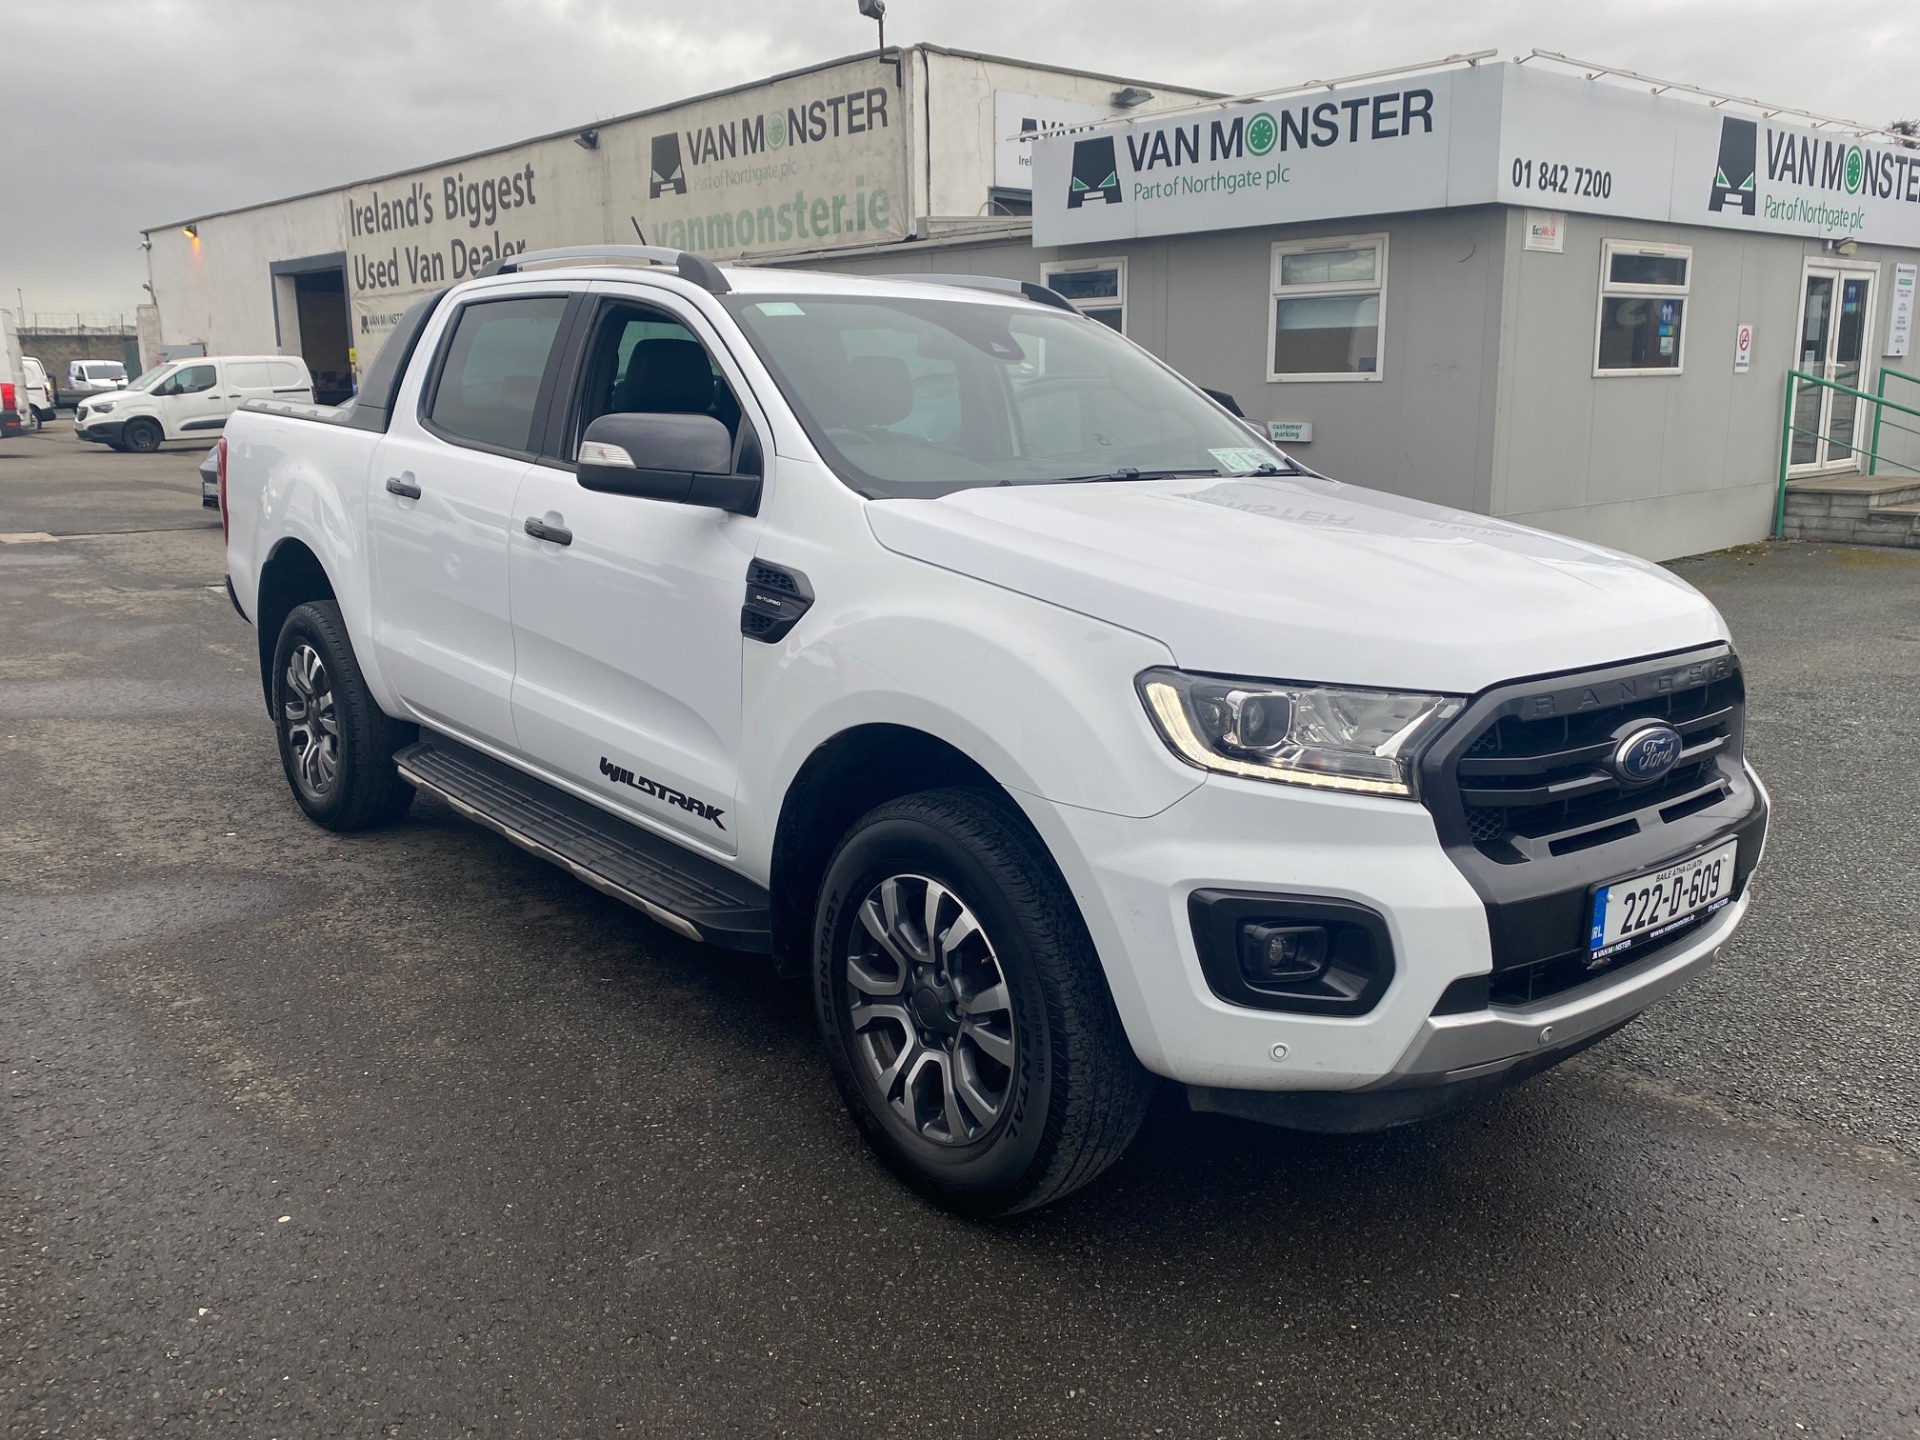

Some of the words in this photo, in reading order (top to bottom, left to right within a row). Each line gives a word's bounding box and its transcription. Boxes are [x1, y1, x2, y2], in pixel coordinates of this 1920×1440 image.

[686, 121, 737, 166] VAN
[742, 86, 888, 156] MONSTER
[1126, 123, 1200, 172] VAN
[1209, 88, 1434, 162] MONSTER
[712, 167, 726, 189] of
[725, 160, 779, 188] Northgate
[780, 156, 797, 184] plc
[1134, 181, 1162, 201] Part
[1163, 175, 1180, 198] of
[1182, 170, 1262, 195] Northgate
[1266, 163, 1291, 190] plc
[1512, 157, 1532, 189] 01
[1538, 161, 1569, 194] 842
[1574, 166, 1612, 199] 7200
[1767, 128, 1819, 187] VAN
[1820, 140, 1920, 204] MONSTE
[350, 181, 434, 237] Ireland's
[443, 162, 536, 229] Biggest
[652, 175, 891, 251] vanmonster.ie
[1764, 194, 1787, 220] Part
[1786, 197, 1800, 221] of
[1798, 199, 1849, 232] Northgate
[1849, 206, 1865, 234] plc
[354, 246, 400, 291] Used
[405, 245, 445, 285] Van
[1272, 423, 1302, 431] customer
[1274, 430, 1300, 440] parking
[1532, 658, 1729, 717] RANGER
[1639, 737, 1675, 770] Ford
[599, 755, 728, 832] WILDTRAK
[1620, 858, 1721, 936] 222-D-609
[1655, 869, 1672, 883] BAILE
